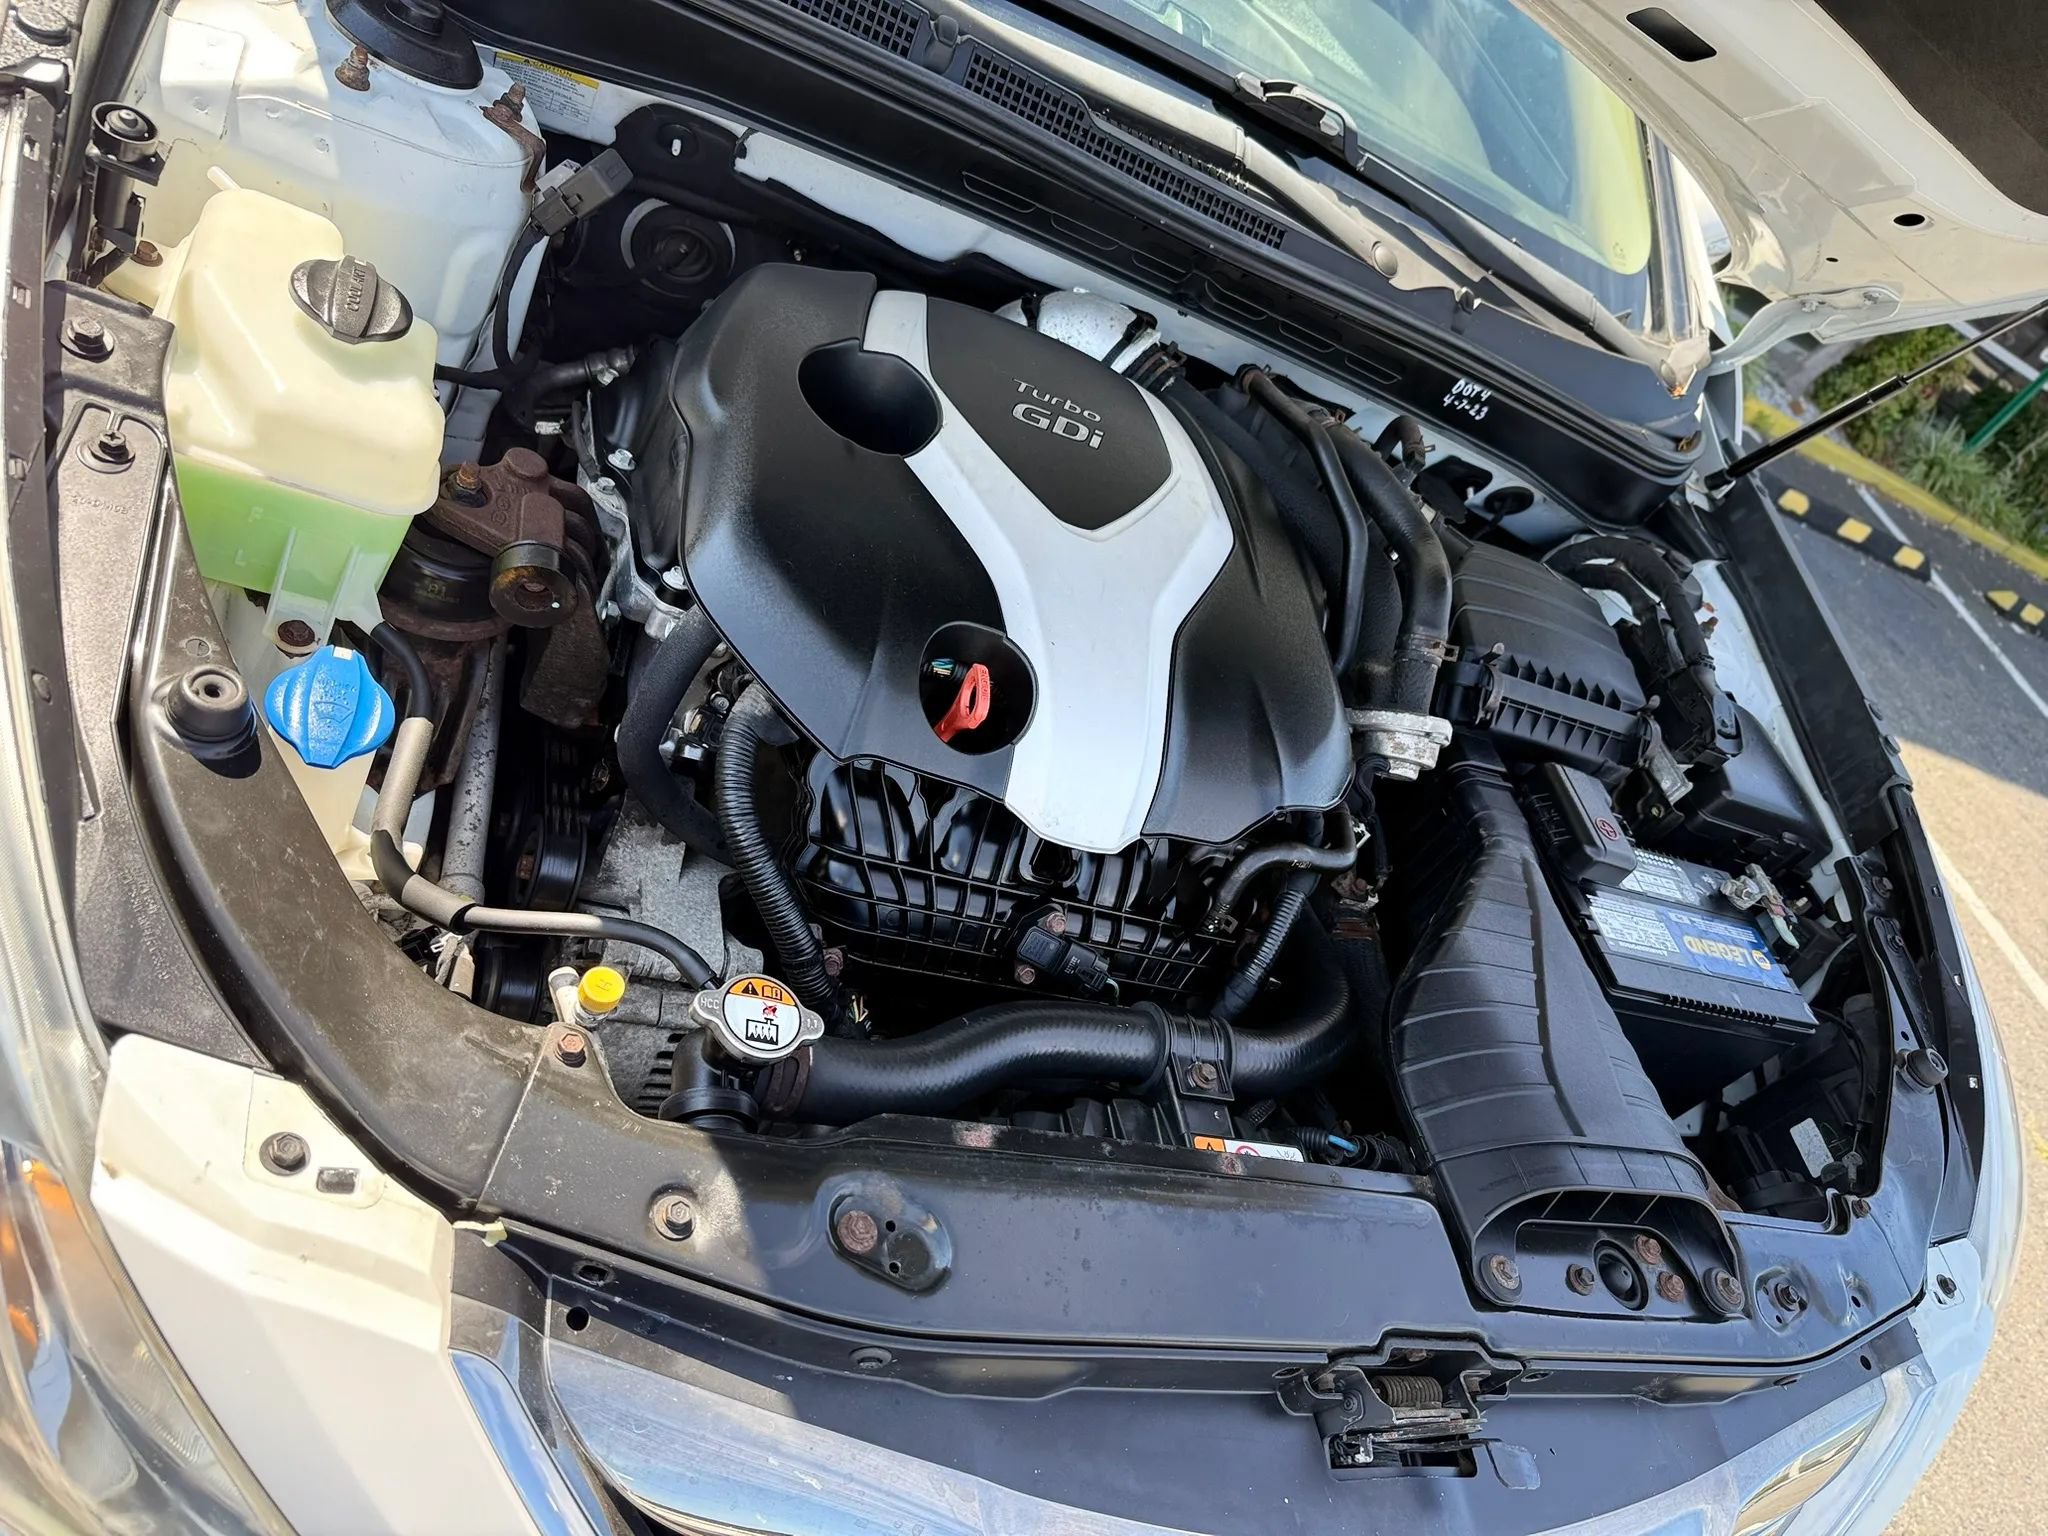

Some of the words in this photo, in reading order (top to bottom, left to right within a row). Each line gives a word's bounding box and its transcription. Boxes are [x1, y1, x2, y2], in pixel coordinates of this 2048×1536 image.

[1012, 378, 1102, 422] Turbo
[1451, 378, 1482, 398] DOT
[1012, 402, 1105, 449] GDi
[1683, 934, 1755, 966] LEGEND
[700, 997, 720, 1010] HCC
